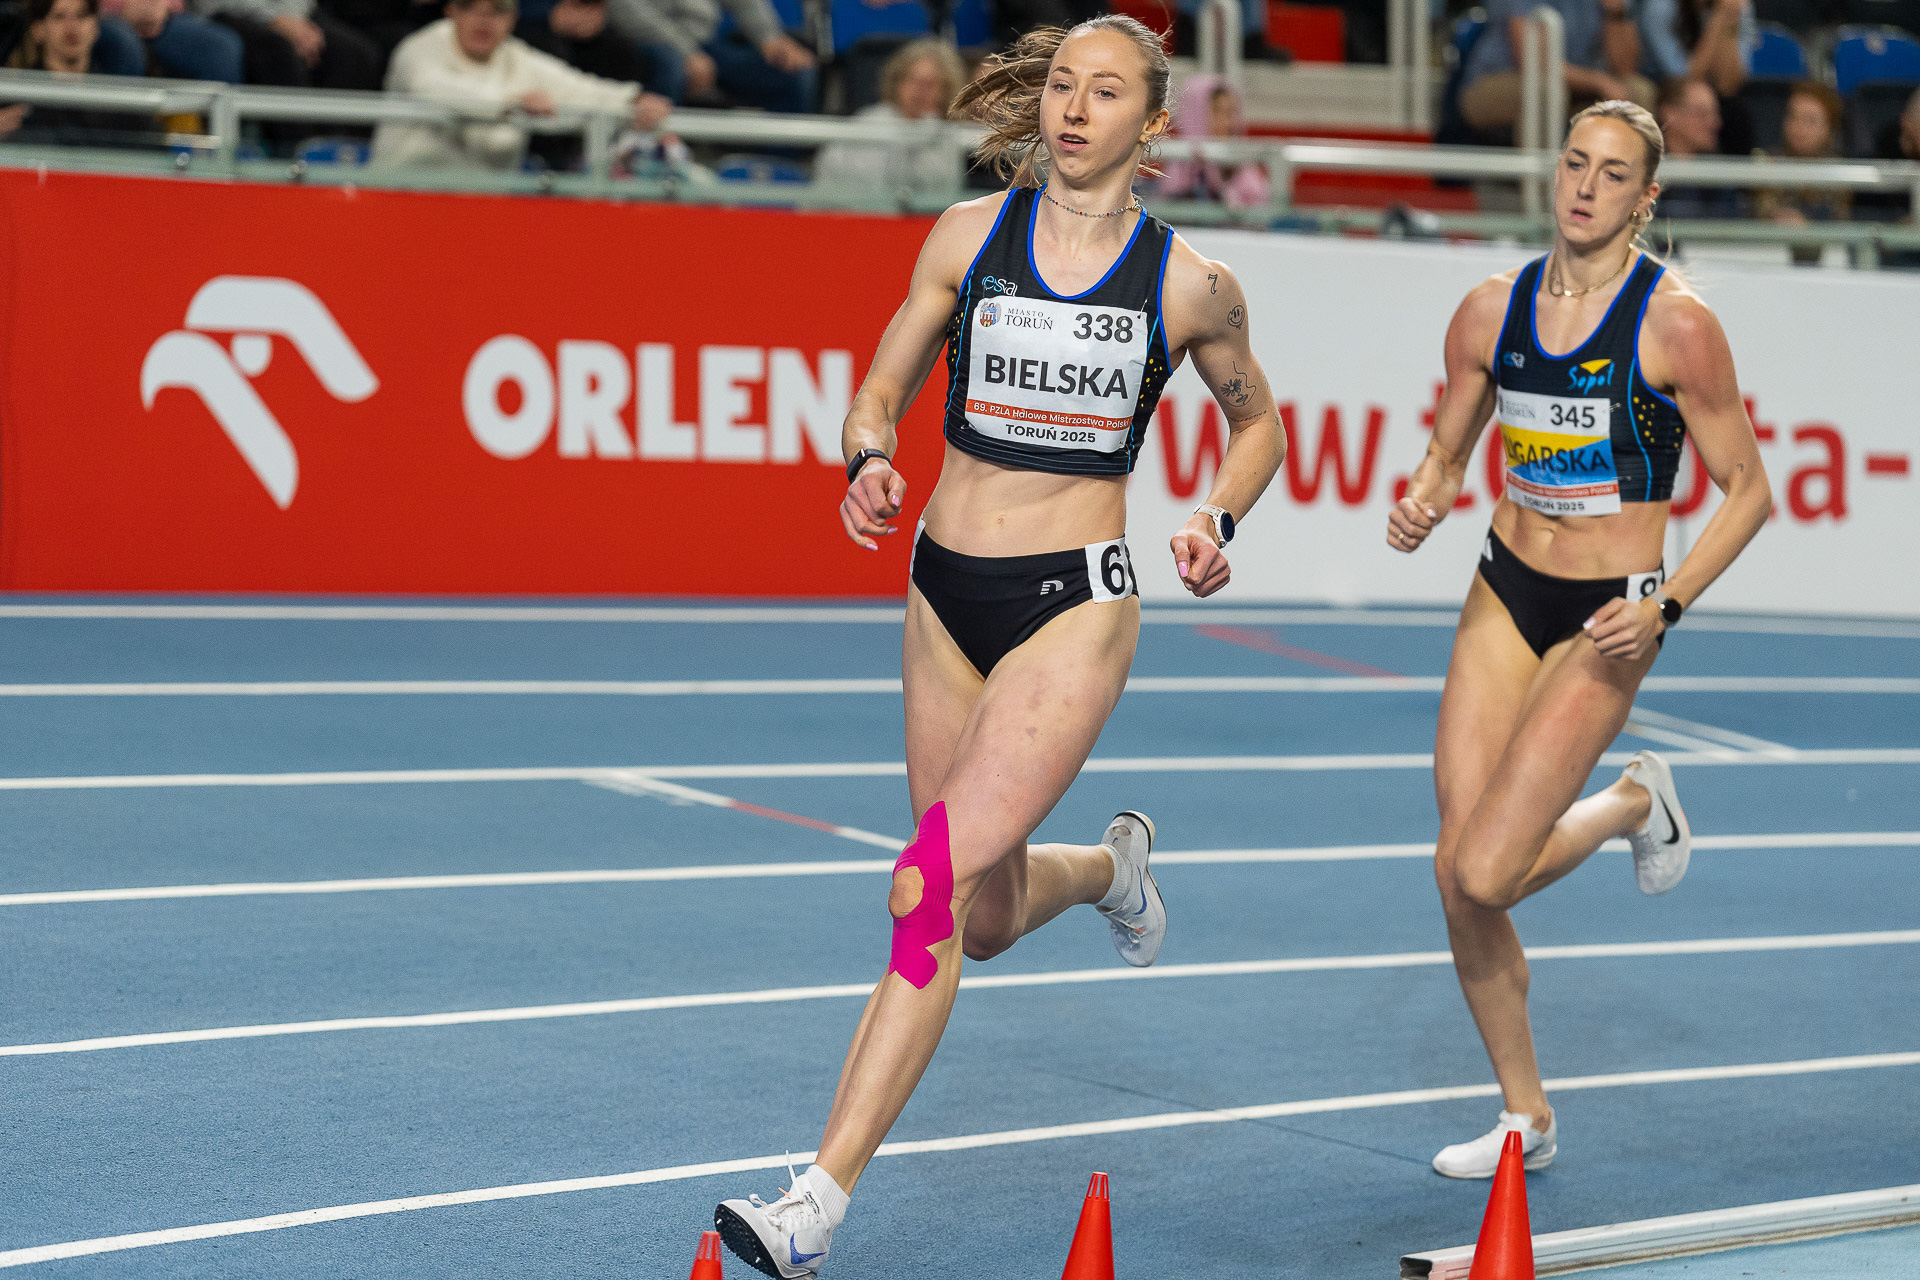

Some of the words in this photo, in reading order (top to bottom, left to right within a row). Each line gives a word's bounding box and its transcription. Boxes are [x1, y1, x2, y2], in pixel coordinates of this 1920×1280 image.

[1004, 315, 1053, 331] TORUŃ
[1007, 307, 1044, 317] MIASTO
[1073, 312, 1133, 344] 338
[984, 353, 1128, 399] BIELSKA
[463, 334, 852, 466] ORLEN
[973, 402, 988, 412] 69.
[990, 405, 1010, 416] PZLA
[1012, 409, 1048, 421] Halowe
[1049, 414, 1105, 427] Mistrzostwa
[1106, 418, 1129, 429] Polski
[1550, 403, 1595, 428] 345
[1005, 424, 1057, 441] TORUŃ
[1060, 431, 1096, 443] 2025
[1101, 544, 1125, 595] 6
